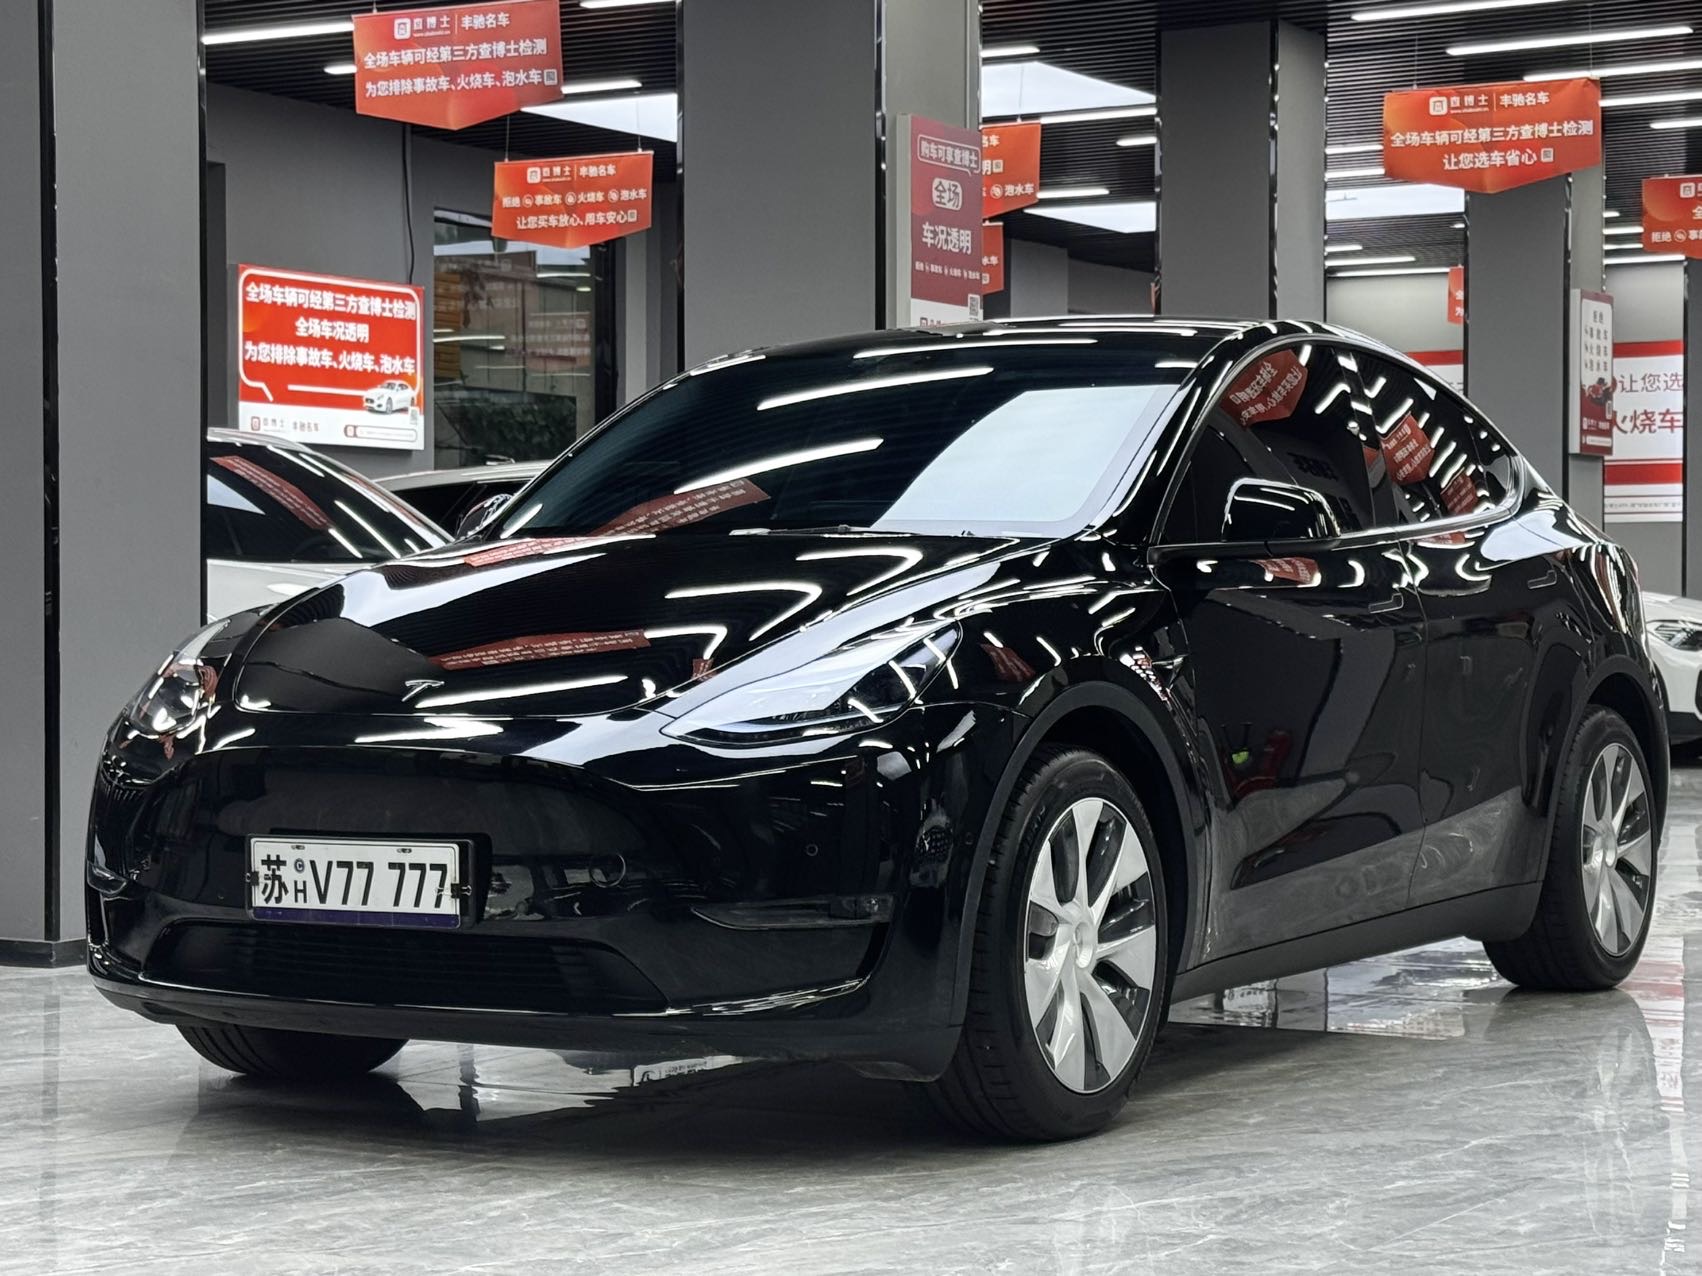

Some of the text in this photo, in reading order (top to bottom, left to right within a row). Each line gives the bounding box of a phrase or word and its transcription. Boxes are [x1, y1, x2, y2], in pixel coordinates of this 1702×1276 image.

[461, 12, 510, 30] 丰驰名车
[363, 38, 547, 69] 全场车辆可经第三方查博士检测
[365, 69, 542, 98] 为您排除事故车、火烧车、泡水车
[1499, 91, 1550, 108] 丰驰名车
[1390, 120, 1594, 148] 全场车辆可经第三方查博士检测
[920, 140, 978, 169] 购车可享查博士
[1442, 148, 1537, 170] 让您选车省心
[934, 180, 961, 210] 全场
[516, 210, 628, 230] 让您买车放心、用车安心
[921, 221, 972, 255] 车况透明
[245, 281, 417, 320] 全场车辆可经第三方查博士检测
[295, 315, 370, 343] 全场车况透明
[244, 340, 416, 376] 为您排除事故车、火烧车、泡水车
